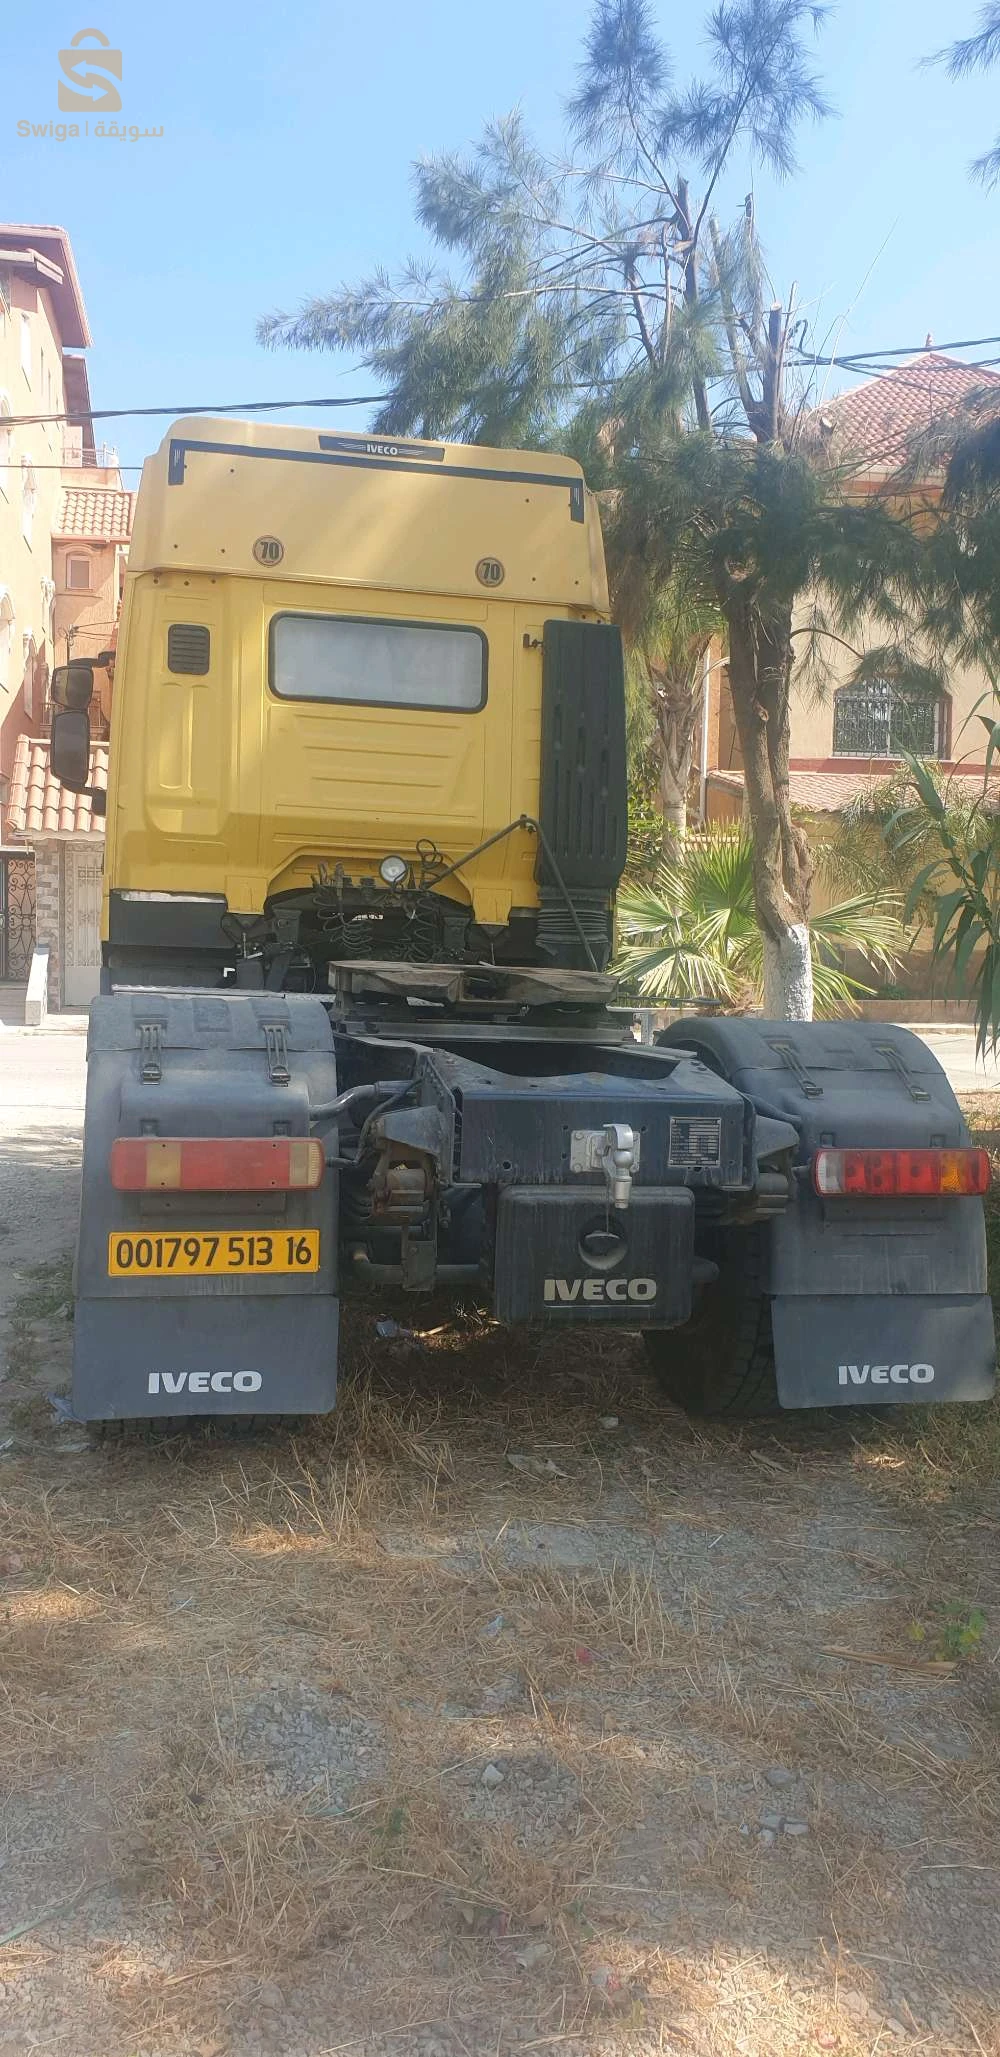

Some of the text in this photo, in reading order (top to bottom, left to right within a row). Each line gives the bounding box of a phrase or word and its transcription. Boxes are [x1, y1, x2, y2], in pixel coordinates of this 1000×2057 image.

[366, 444, 398, 455] IVECO
[260, 541, 280, 560] 70
[483, 562, 500, 580] 70
[116, 1236, 312, 1269] 001797 513 16
[543, 1278, 657, 1301] IVECO
[148, 1370, 263, 1394] IVECO
[838, 1363, 935, 1385] IVECO
